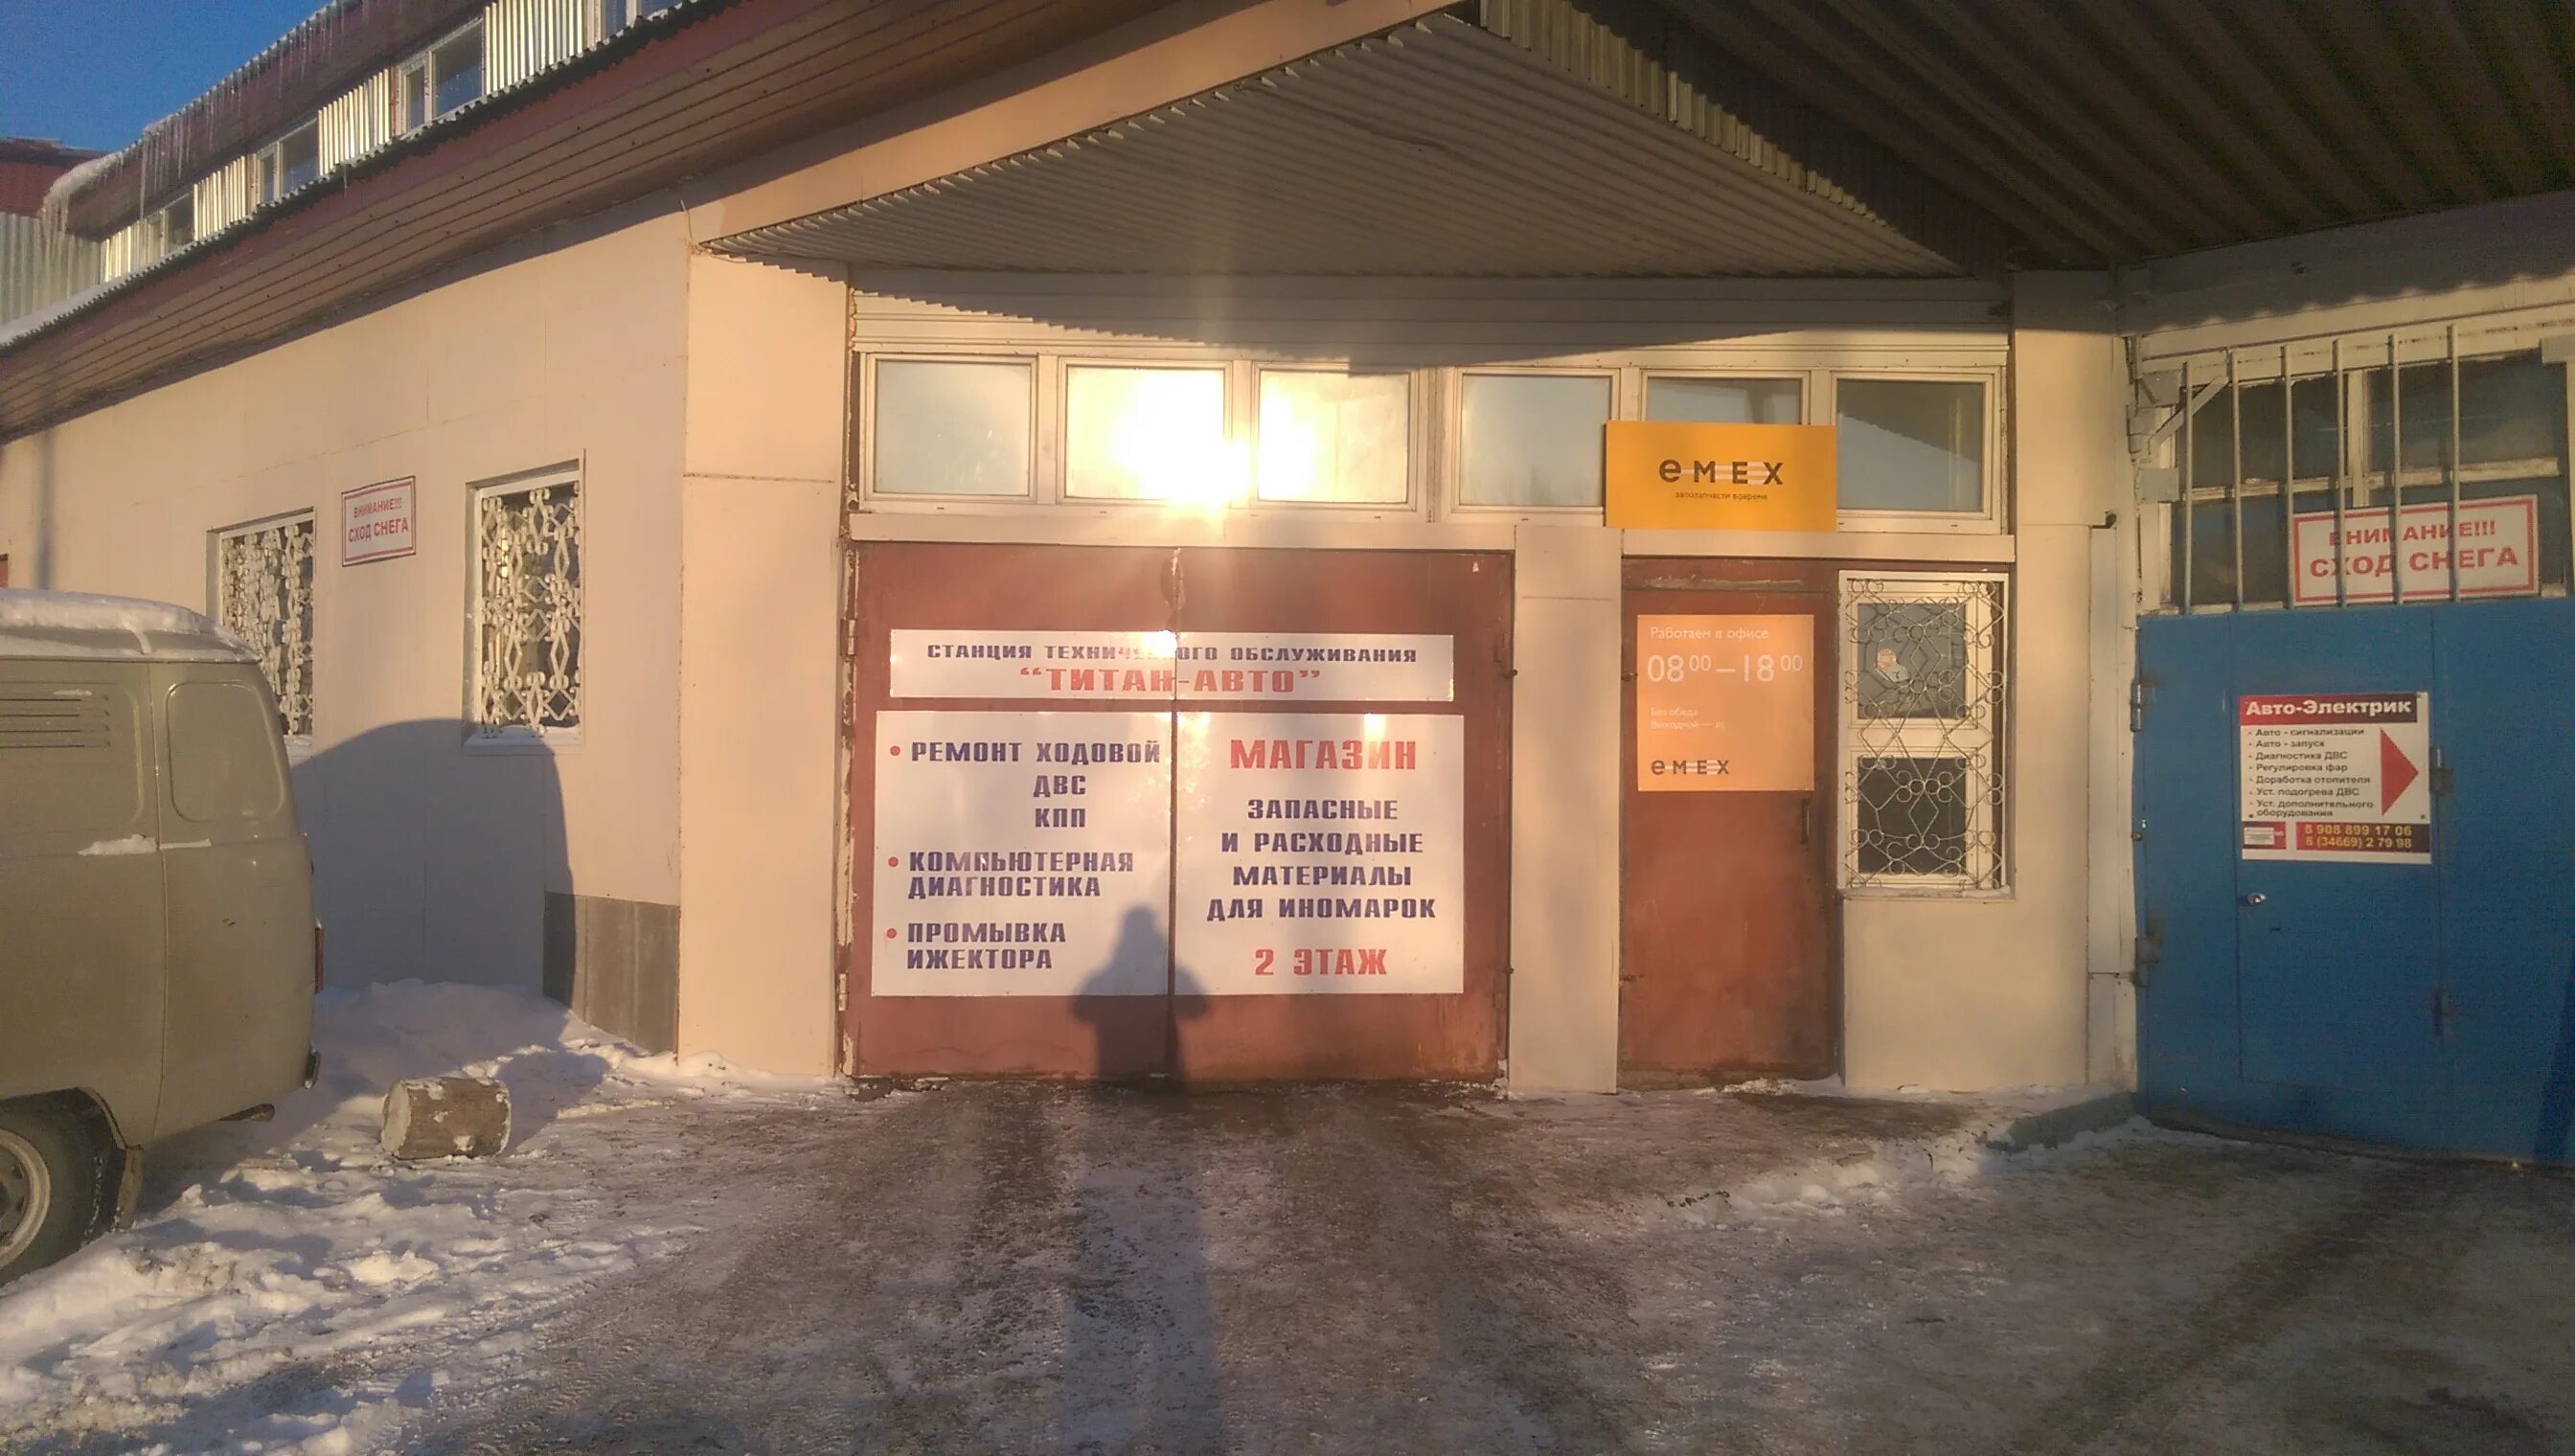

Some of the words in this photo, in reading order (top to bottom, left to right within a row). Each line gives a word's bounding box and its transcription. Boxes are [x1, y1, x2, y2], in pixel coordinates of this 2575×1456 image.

[353, 497, 402, 518] ВНИМАНИЕ!!!
[349, 524, 371, 542] СХОД
[374, 517, 408, 536] СНЕГА
[2310, 554, 2395, 578] СХОД
[2409, 546, 2518, 571] СНЕГА
[1651, 626, 1711, 639] Работаем
[1727, 626, 1769, 642] офисе
[927, 644, 1032, 661] СТАНЦИЯ
[1231, 647, 1417, 663] ОБСЛУЖИВАНИЯ
[2246, 699, 2411, 717] Авто-Электрик
[911, 741, 1022, 763] РЕМОНТ
[1037, 740, 1160, 764] ХОДОВОЙ
[1230, 739, 1416, 770] МАГАЗИН
[2291, 740, 2325, 749] запуск
[2256, 752, 2321, 761] Диагностика
[2325, 752, 2347, 761] ДВС
[2256, 764, 2322, 773] Регулировка
[2326, 764, 2347, 773] фар
[1033, 775, 1086, 798] ДВС
[2256, 776, 2312, 785] Доработка
[2336, 788, 2359, 797] ДВС
[1247, 799, 1398, 820] ЗАПАСНЫЕ
[2257, 809, 2333, 818] оборудования
[2279, 801, 2374, 809] дополнительного
[1035, 808, 1086, 828] КПП
[2375, 826, 2389, 835] 17
[1221, 833, 1239, 853] И
[1254, 832, 1424, 855] РАСХОДНЫЕ
[2366, 838, 2374, 847] 2
[2378, 838, 2392, 848] 79
[909, 852, 1133, 873] КОМПЬЮТЕРНАЯ
[1233, 866, 1411, 886] МАТЕРИАЛЫ
[907, 876, 1101, 899] ДИАГНОСТИКА
[1206, 899, 1263, 921] ДЛЯ
[1279, 899, 1436, 920] ИНОМАРОК
[907, 922, 1065, 944] ПРОМЫВКА
[906, 949, 1053, 969] ИЖЕКТОРА
[1254, 950, 1274, 976] 2
[1294, 949, 1386, 976] ЭТАЖ
